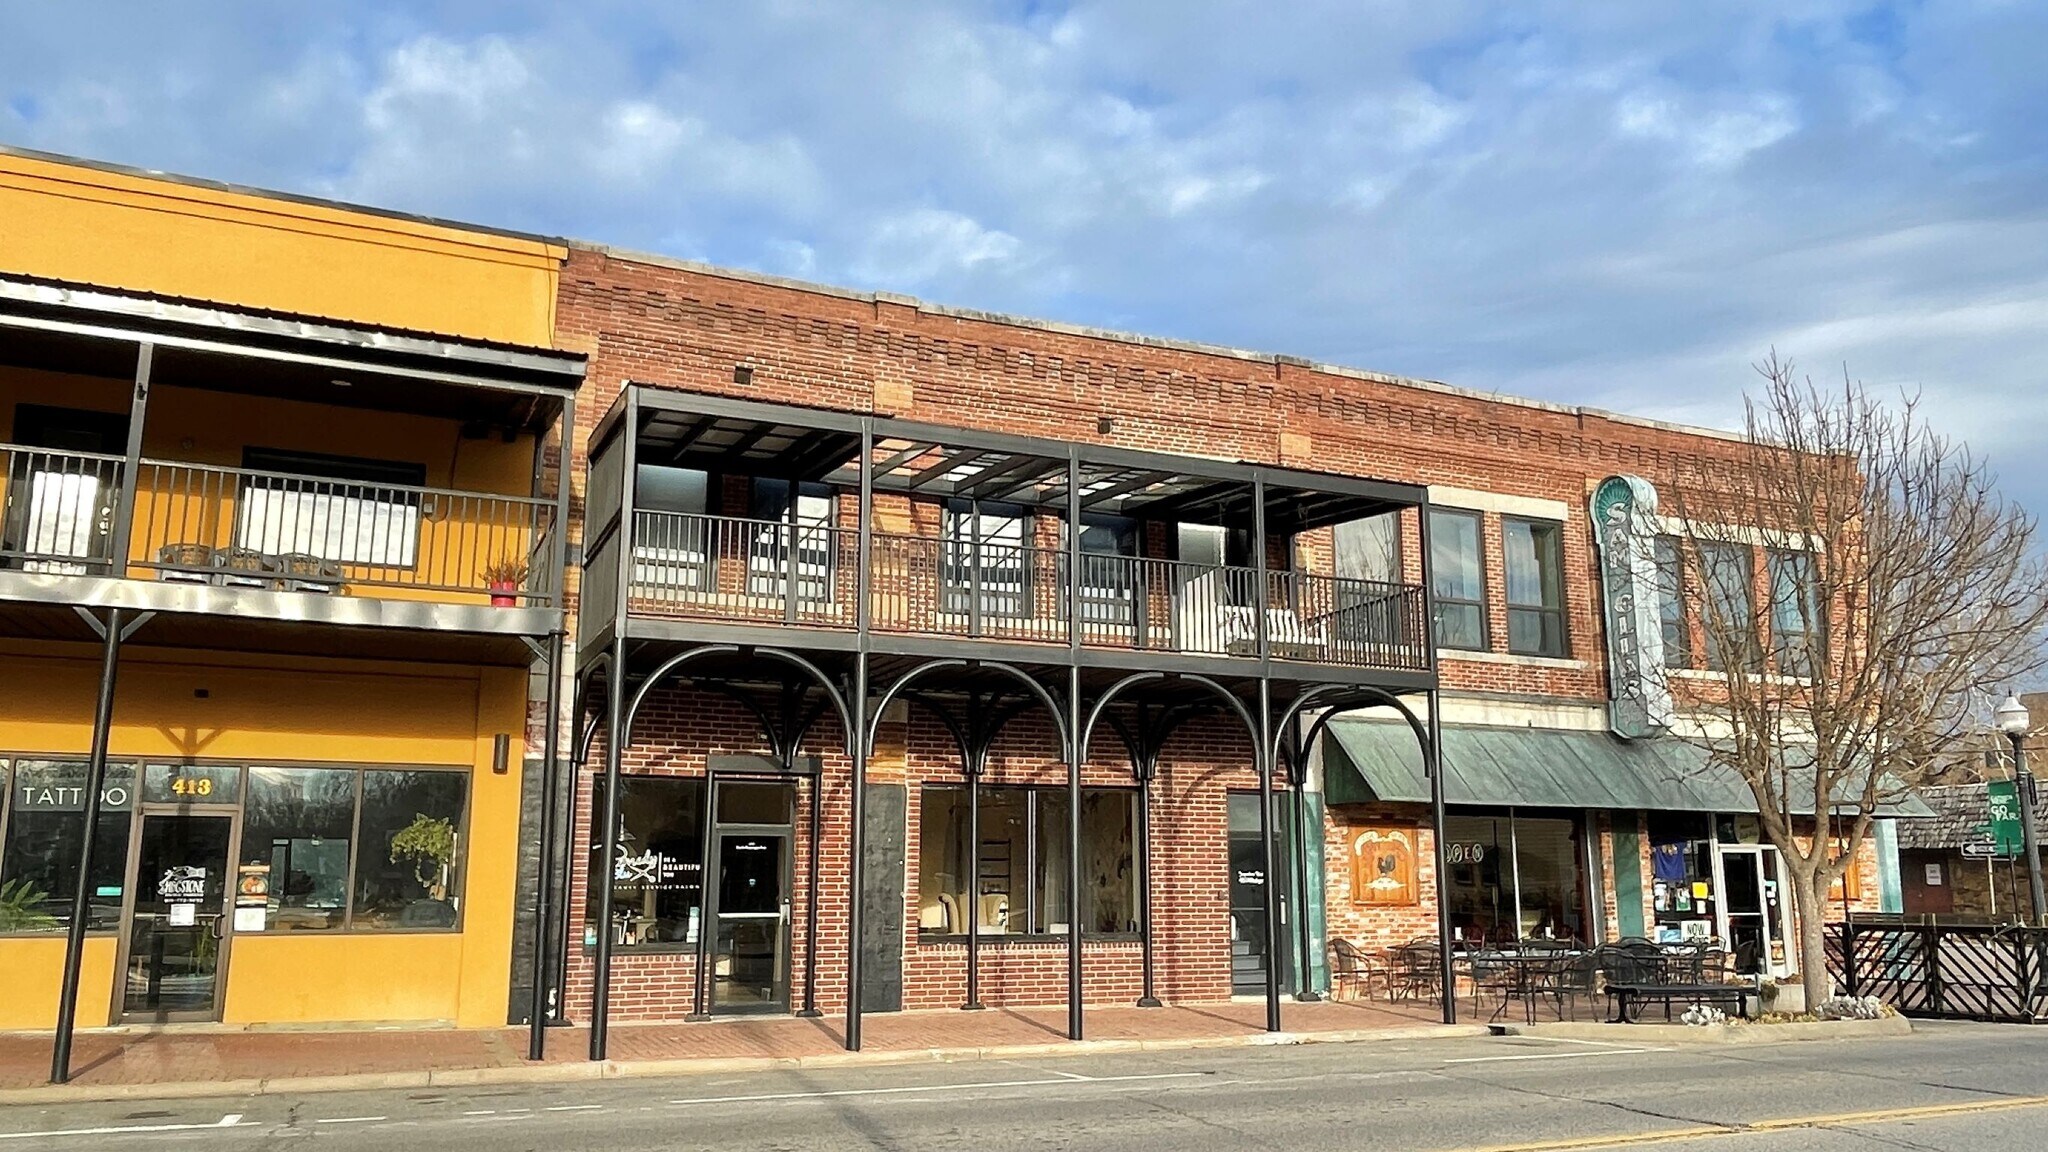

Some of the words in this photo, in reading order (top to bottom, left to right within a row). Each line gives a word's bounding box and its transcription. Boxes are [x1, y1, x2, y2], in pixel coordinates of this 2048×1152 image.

[171, 777, 212, 796] 413
[22, 787, 127, 806] TATTO
[1990, 805, 2008, 815] GO
[1687, 923, 1705, 936] NOW
